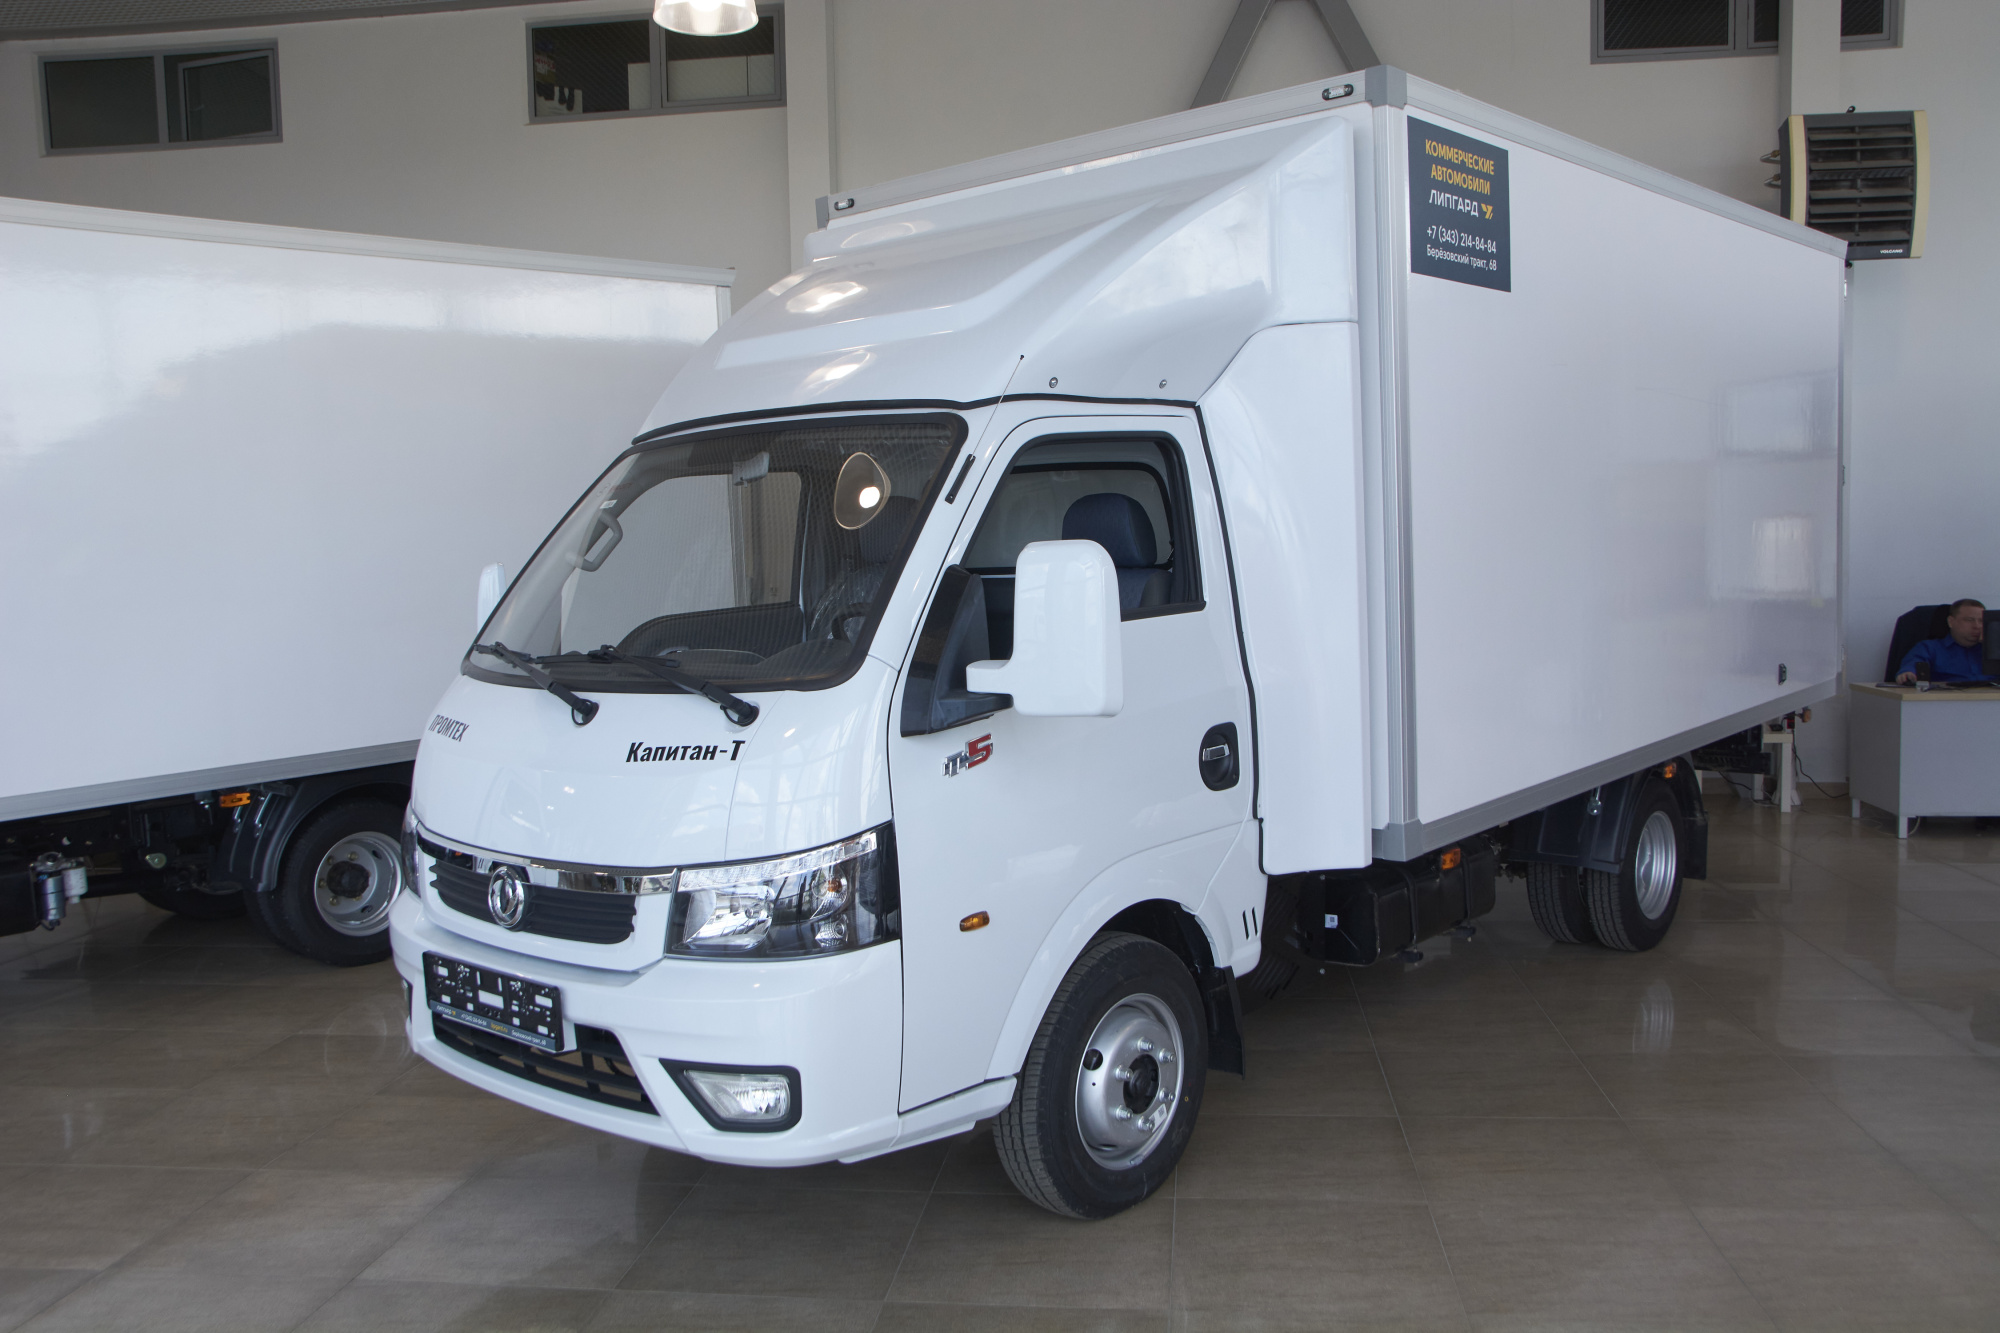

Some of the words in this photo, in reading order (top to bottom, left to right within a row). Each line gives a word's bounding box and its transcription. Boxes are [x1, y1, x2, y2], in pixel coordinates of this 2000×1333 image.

[1425, 139, 1495, 175] КОММЕРЧЕСКИЕ
[1431, 164, 1490, 195] АВТОМОБИЛИ
[1429, 189, 1479, 217] ЛИПГАРД
[1427, 225, 1437, 239] +7
[1438, 225, 1459, 247] (343)
[1460, 232, 1497, 254] 214-84-84
[1470, 256, 1488, 271] тракт,
[428, 714, 470, 742] ПРОМТЕХ
[625, 740, 746, 763] Капитан-Т
